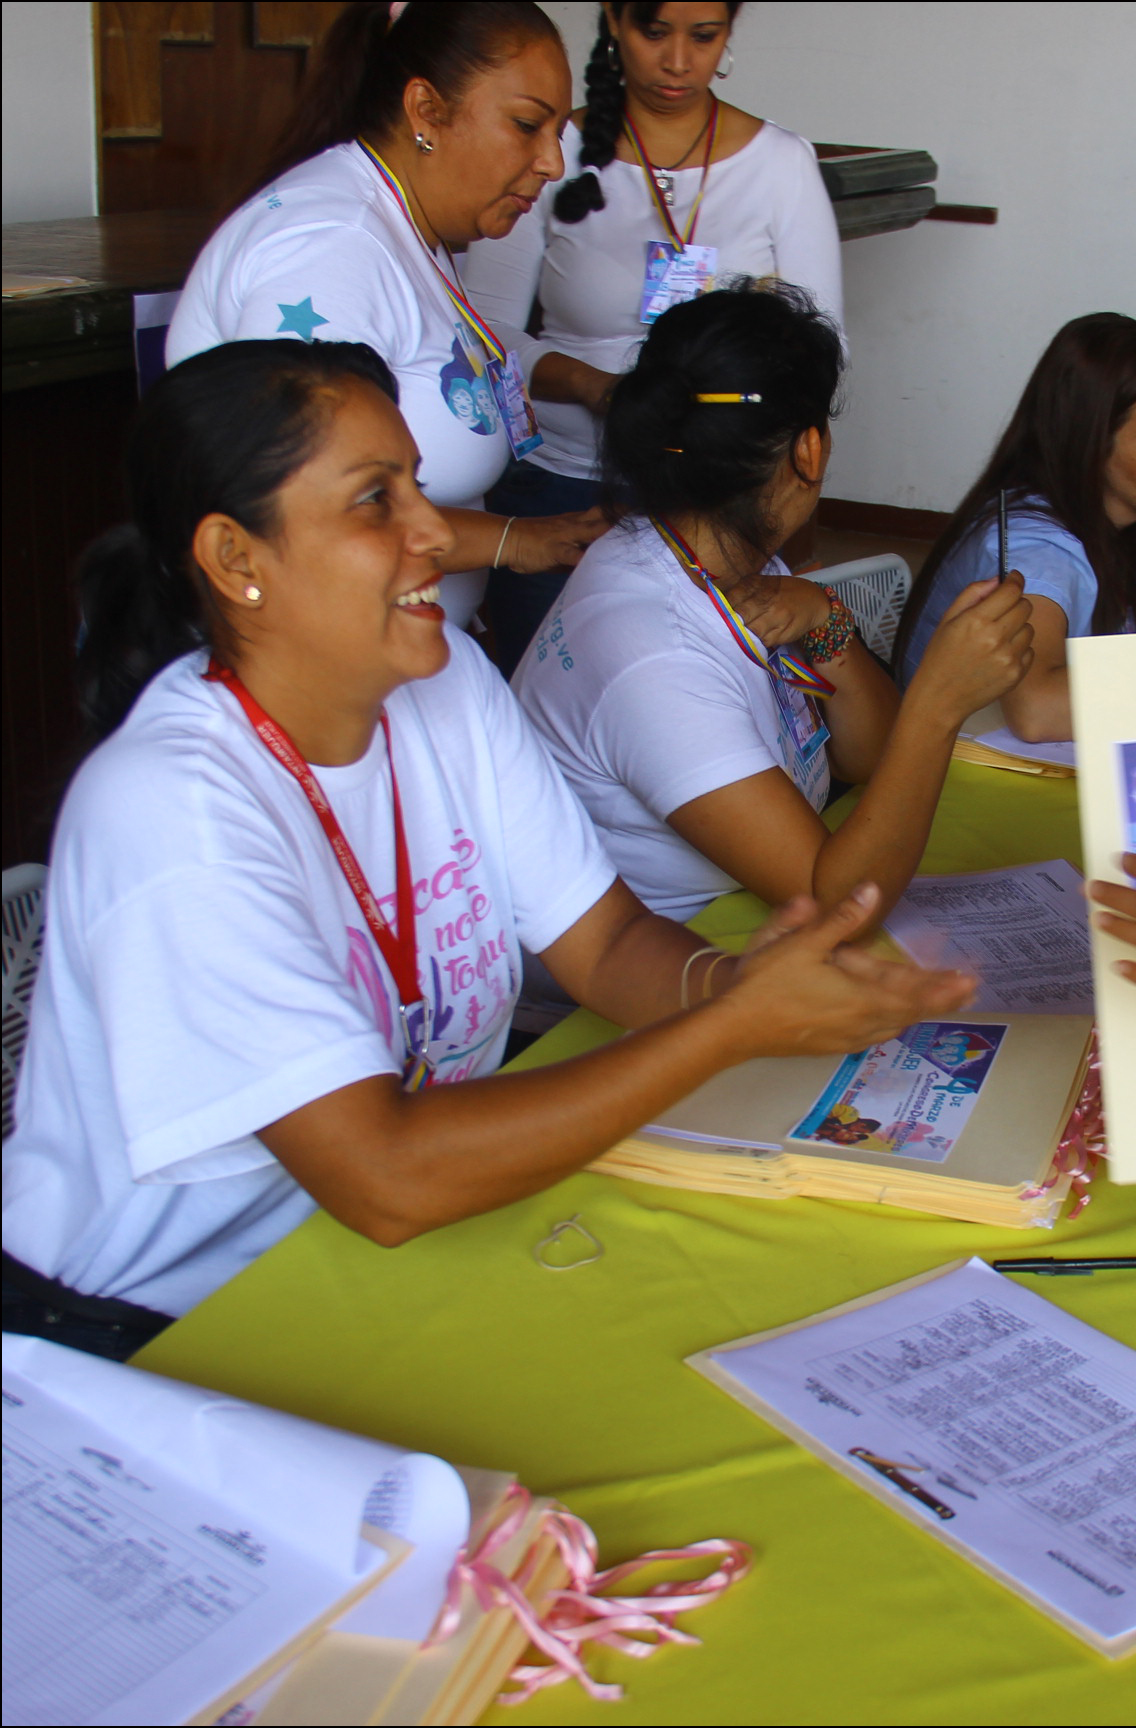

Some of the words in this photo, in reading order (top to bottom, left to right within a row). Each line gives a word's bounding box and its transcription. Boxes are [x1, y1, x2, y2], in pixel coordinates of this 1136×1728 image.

[931, 1076, 979, 1095] 4
[926, 1092, 948, 1123] MARZO
[949, 1095, 965, 1108] DE
